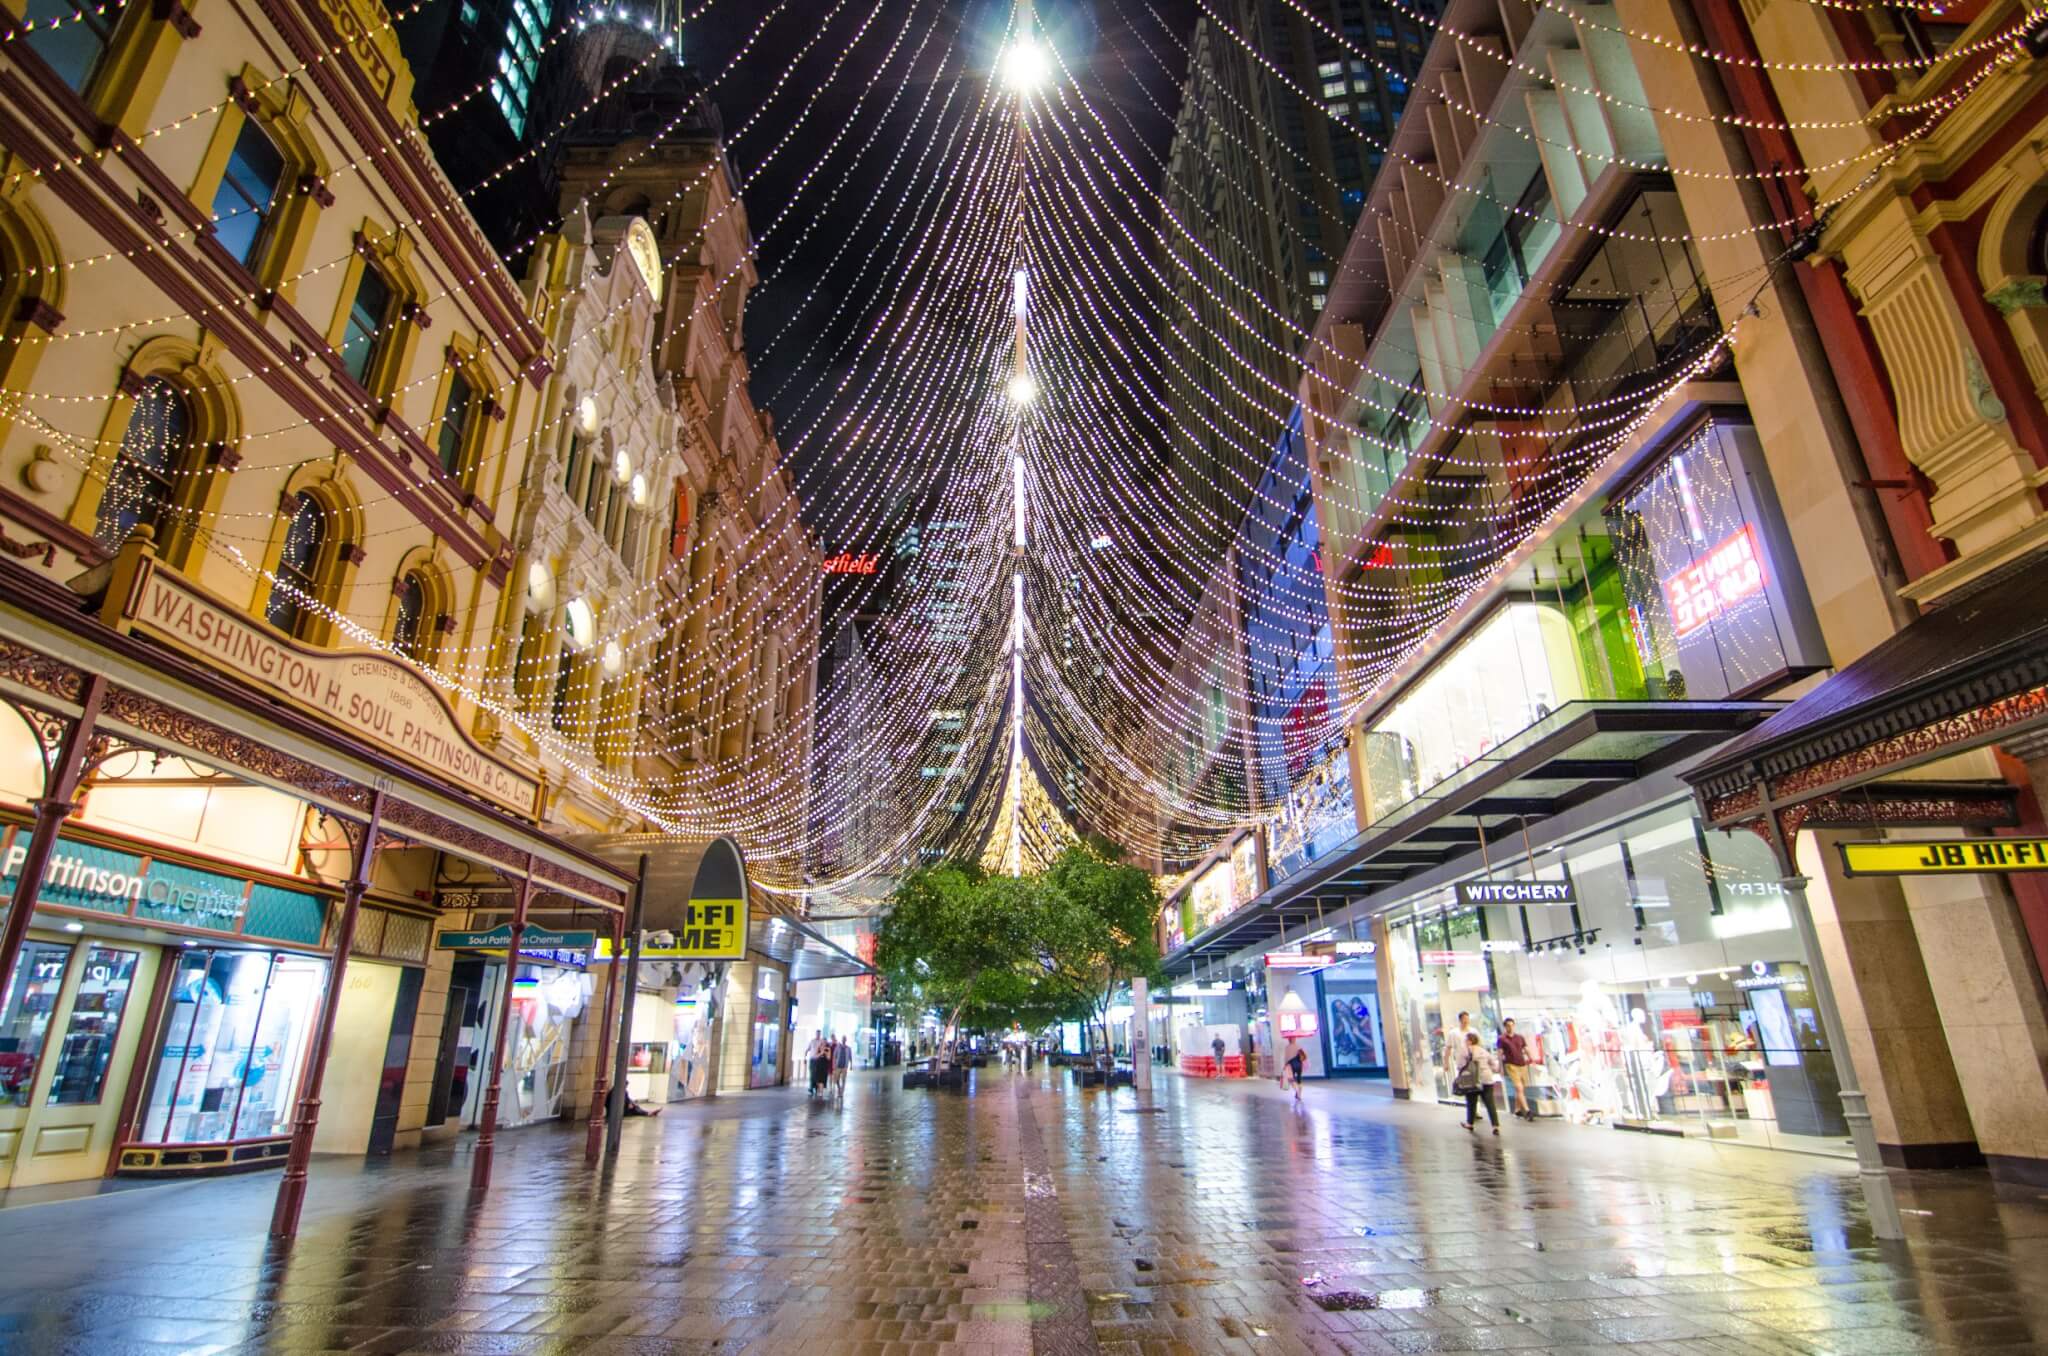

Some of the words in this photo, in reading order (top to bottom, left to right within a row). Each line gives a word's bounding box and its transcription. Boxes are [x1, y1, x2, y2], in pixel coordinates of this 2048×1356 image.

[823, 553, 877, 573] stfield
[351, 663, 397, 681] CHEMISTS
[154, 584, 320, 698] WASHINGTON
[324, 680, 344, 712] H.
[348, 693, 394, 739] SOUL
[401, 721, 481, 782] PATTINSON
[483, 765, 493, 785] &
[1920, 845, 1966, 867] JB
[3, 844, 142, 900] Pttinson
[147, 876, 249, 914] Chemist
[1465, 884, 1569, 900] WITCHERY
[467, 935, 487, 945] Soul
[488, 935, 528, 945] Pattinn
